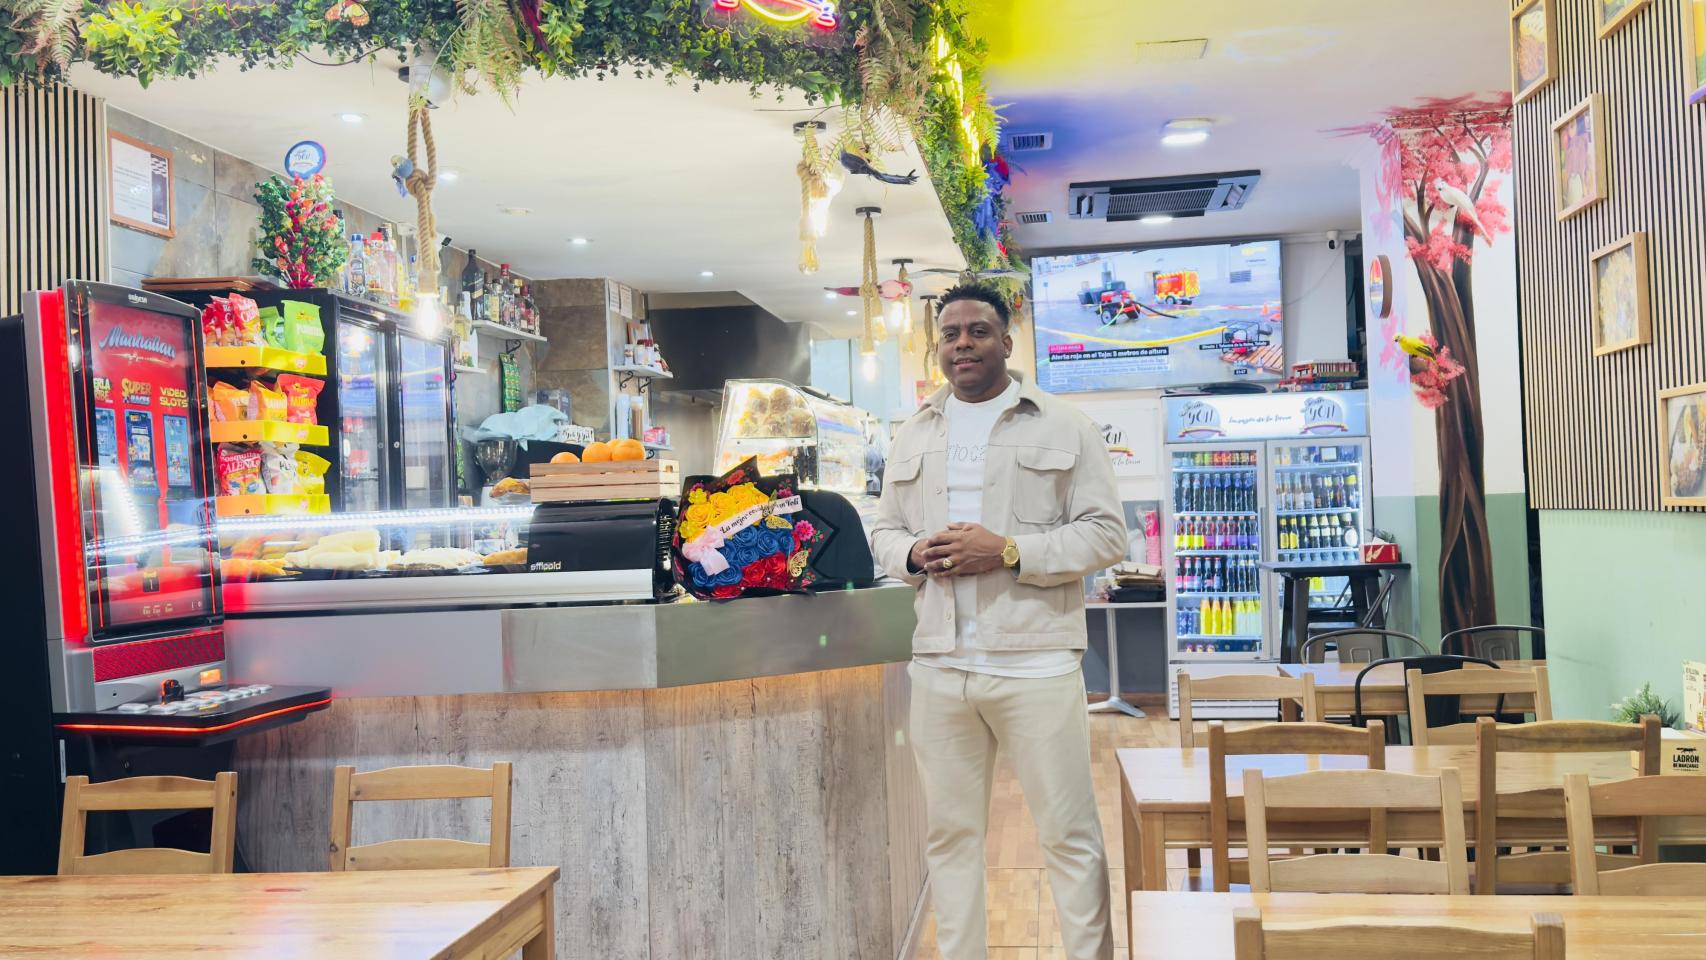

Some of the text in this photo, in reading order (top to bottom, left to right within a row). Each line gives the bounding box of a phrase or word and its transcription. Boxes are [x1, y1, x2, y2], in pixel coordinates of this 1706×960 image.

[1051, 353, 1069, 361] Alerta
[1118, 349, 1139, 357] metros
[1148, 347, 1167, 355] altura
[121, 377, 152, 396] SUPER
[160, 386, 187, 398] VIDEO
[159, 396, 189, 408] SLOTS
[731, 513, 748, 526] mejor
[1673, 754, 1699, 763] LADRON
